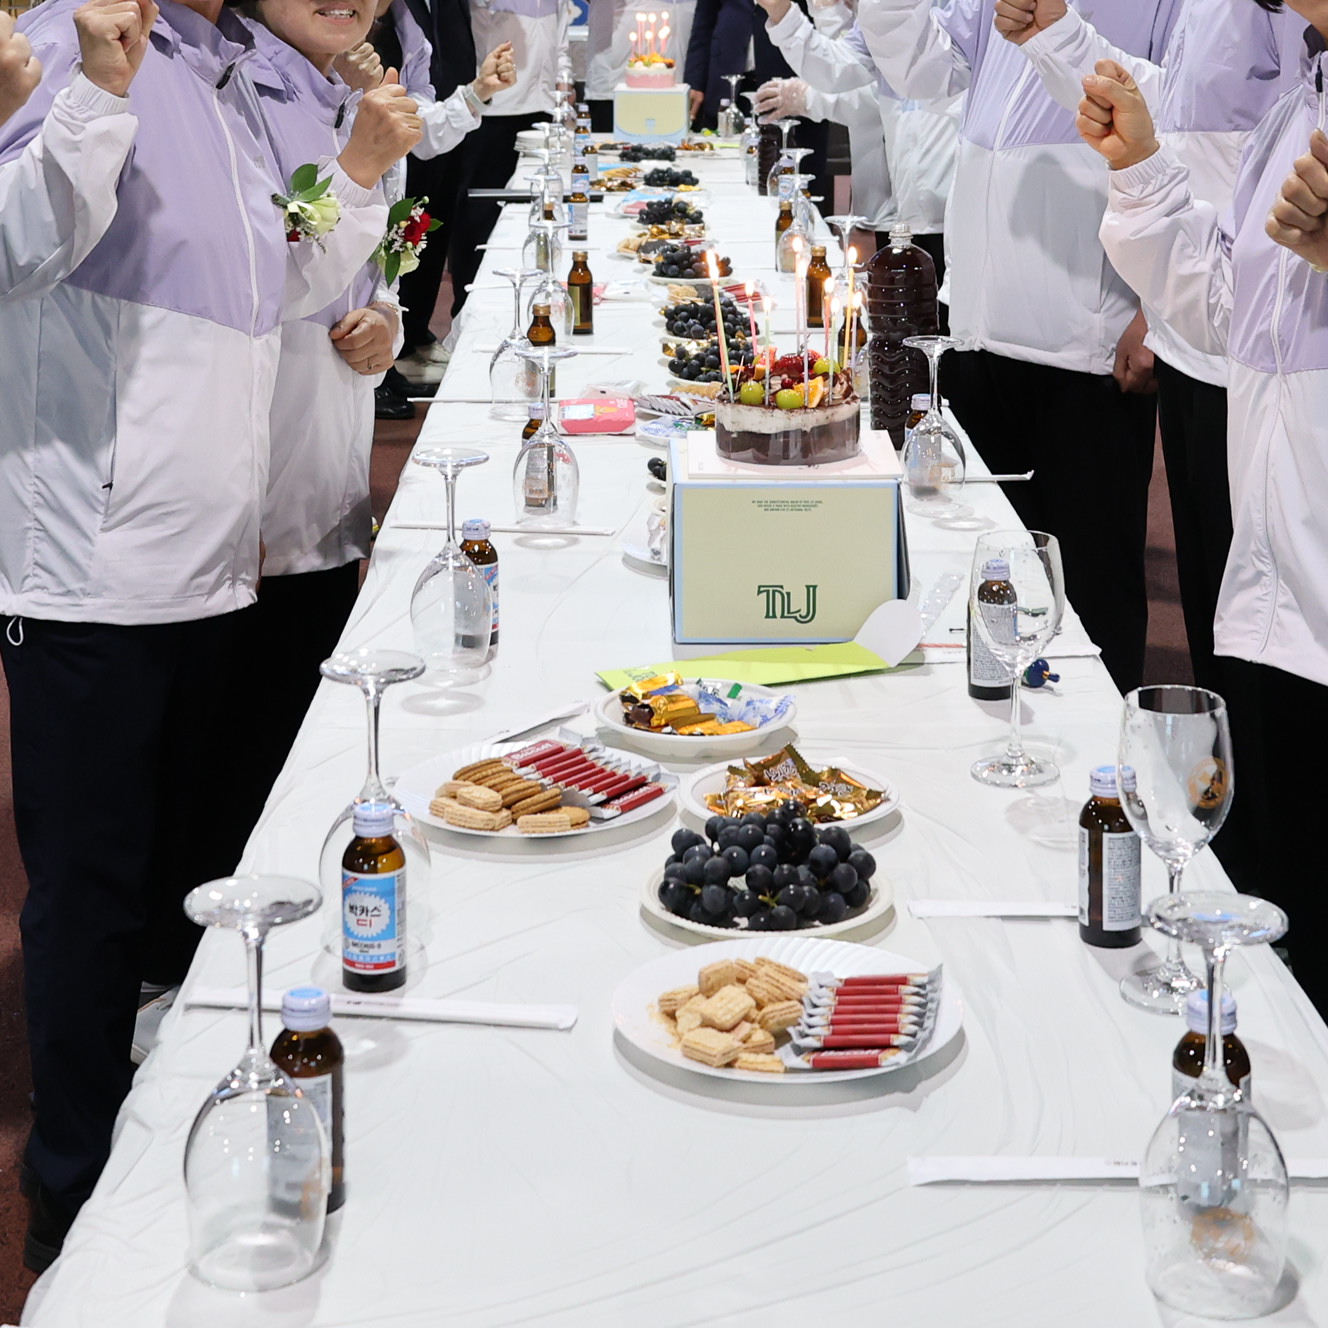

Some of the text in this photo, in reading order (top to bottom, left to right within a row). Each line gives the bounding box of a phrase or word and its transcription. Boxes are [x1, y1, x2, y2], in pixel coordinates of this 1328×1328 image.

[757, 584, 818, 624] TLJ
[348, 903, 382, 918] 박카스
[356, 918, 373, 928] 디
